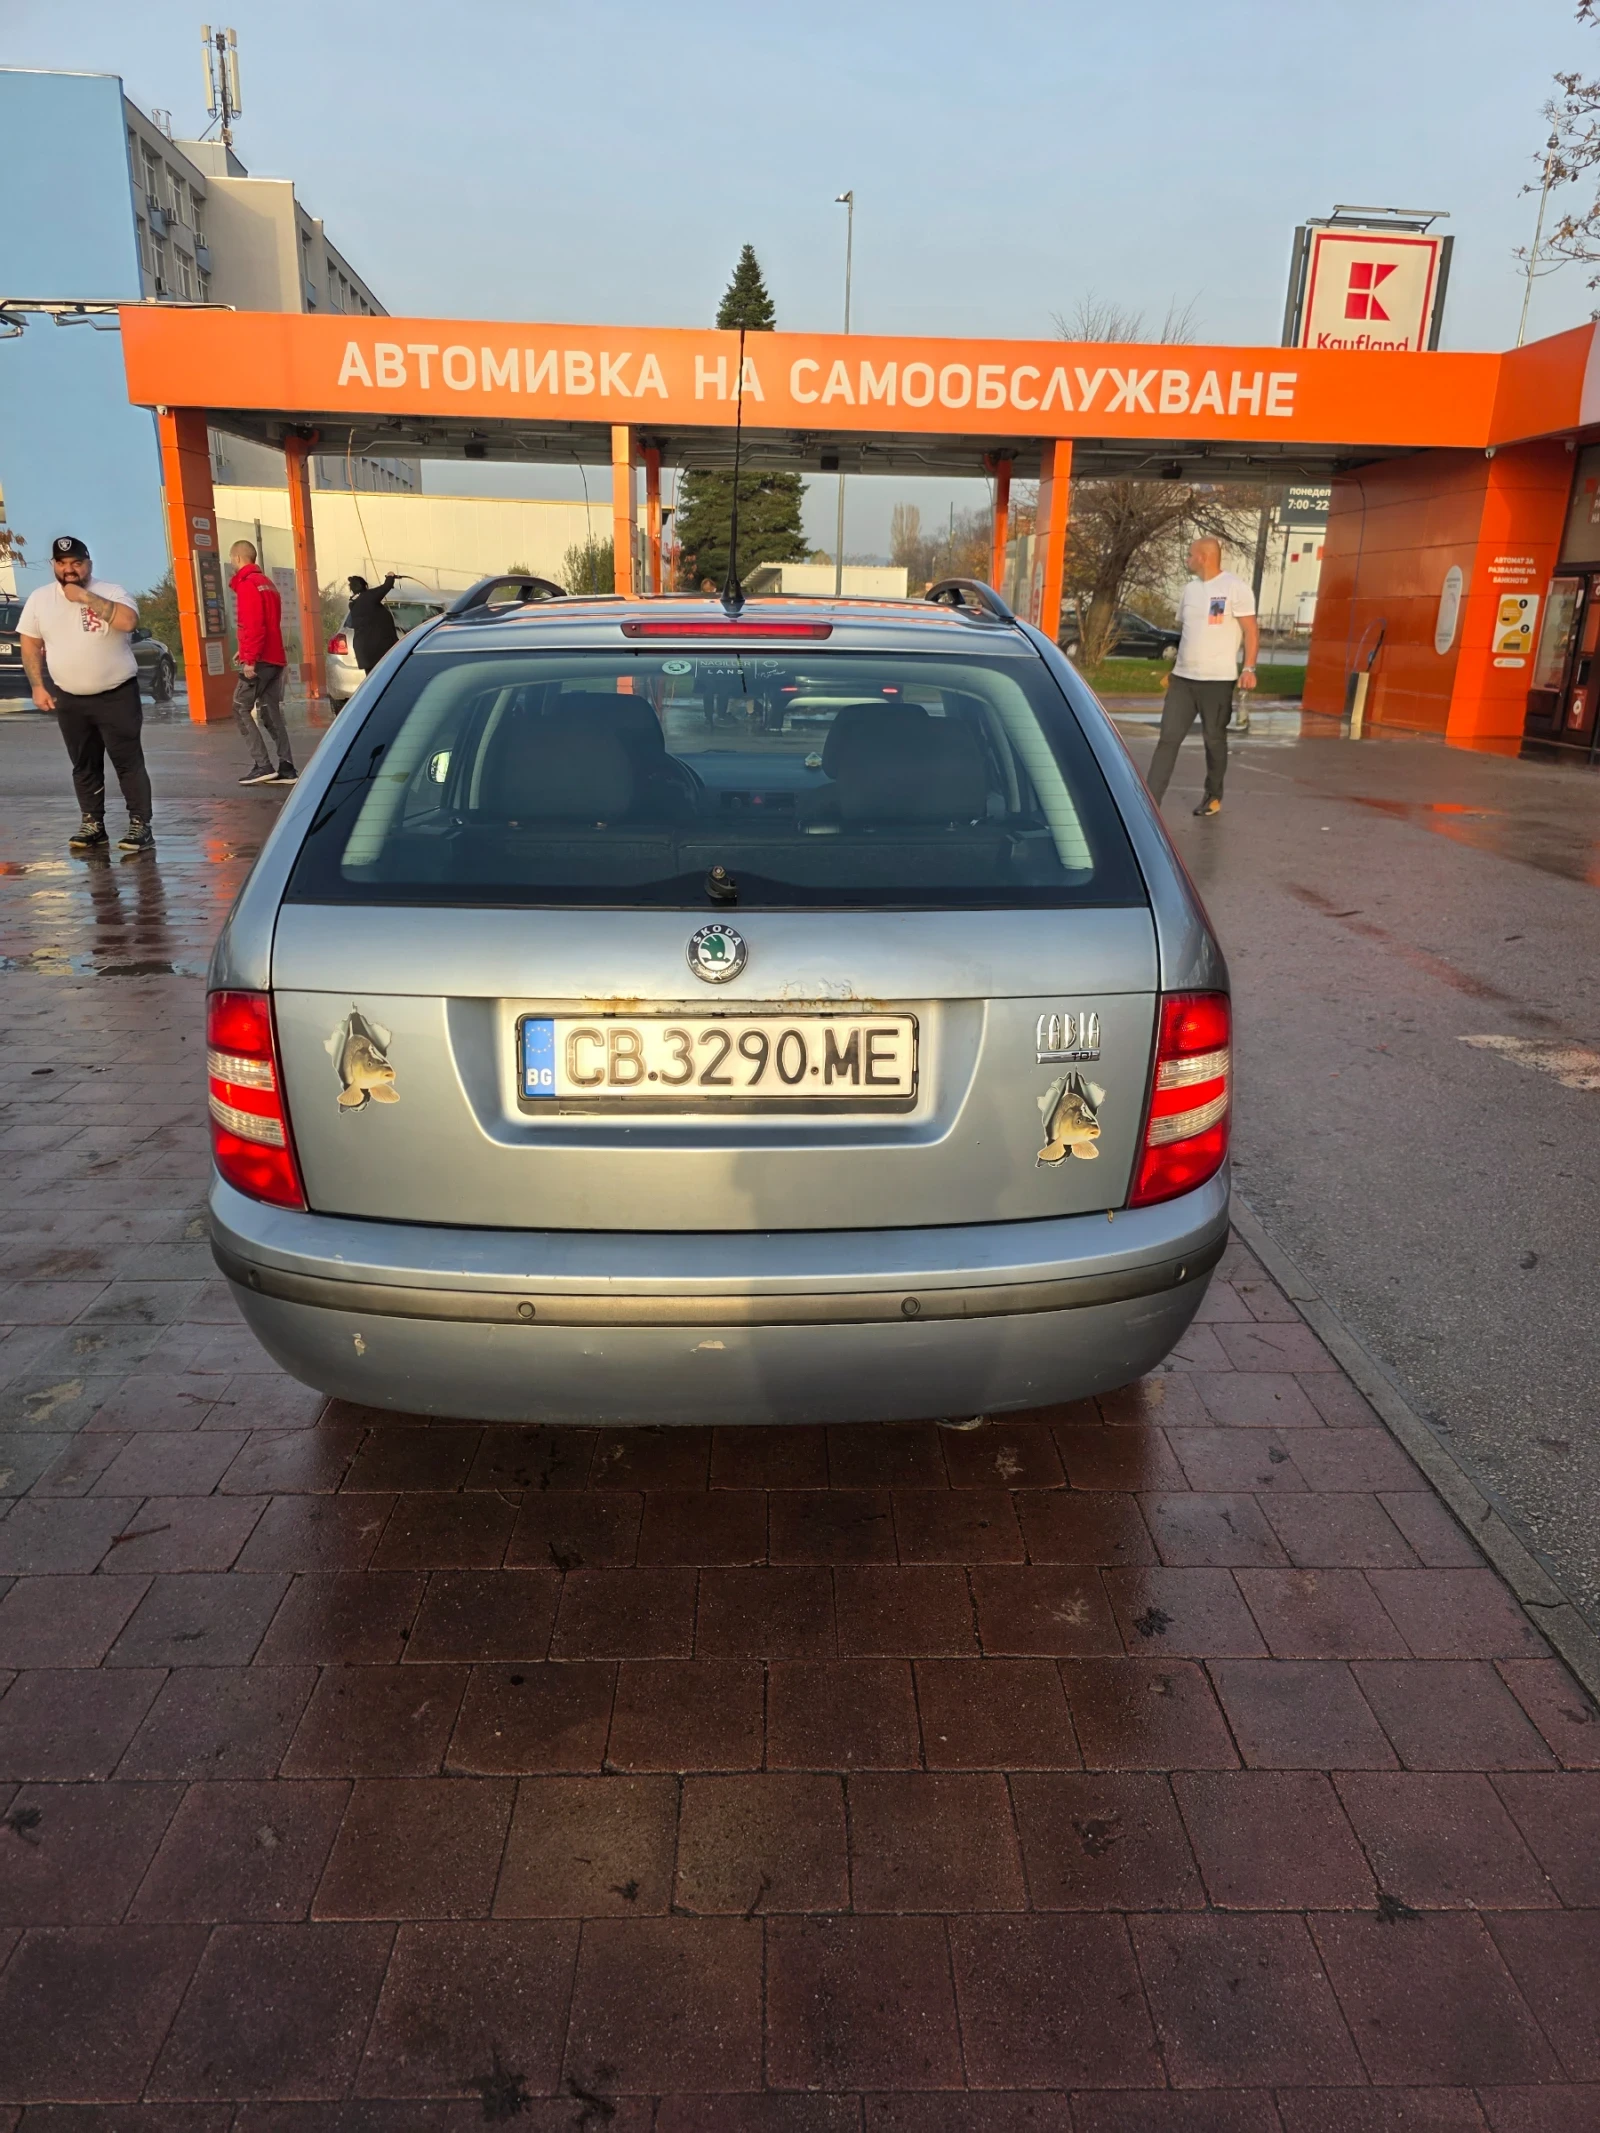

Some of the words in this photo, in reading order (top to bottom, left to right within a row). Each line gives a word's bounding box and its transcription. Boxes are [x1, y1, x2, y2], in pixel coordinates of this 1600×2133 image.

[338, 341, 669, 399] АВТОМИВКА
[694, 355, 765, 402] НА
[788, 358, 1298, 417] САМООБСЛУЖВАНЕ
[1493, 556, 1524, 564] АВТОМАТ
[1036, 1012, 1100, 1050] FABIA
[1071, 1051, 1093, 1061] TDI
[526, 1068, 552, 1086] BG
